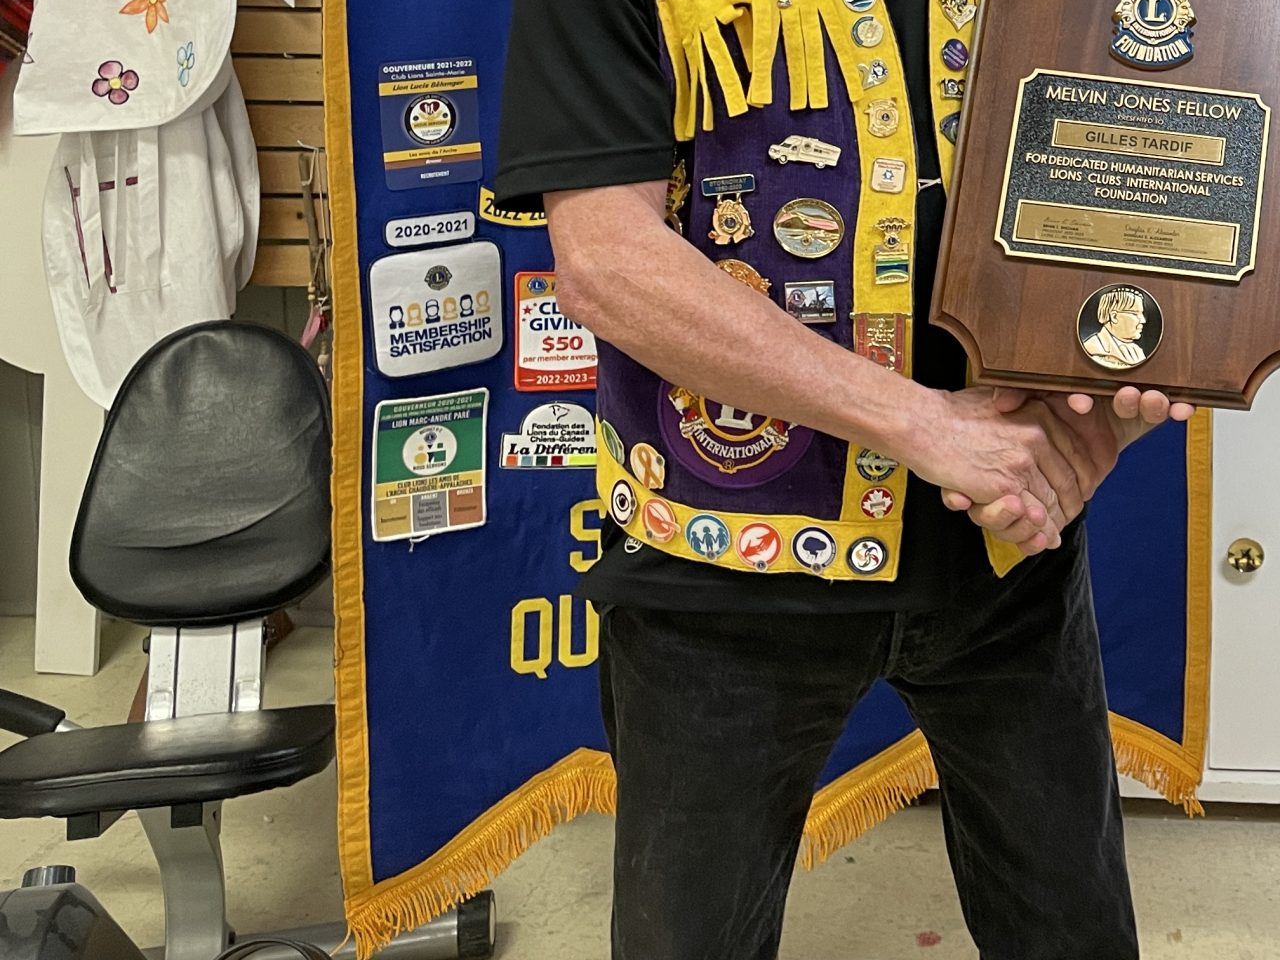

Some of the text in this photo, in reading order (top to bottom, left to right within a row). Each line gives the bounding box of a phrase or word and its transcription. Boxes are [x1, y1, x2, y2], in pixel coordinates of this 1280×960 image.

[1115, 35, 1190, 62] FOUNDATION
[383, 60, 473, 74] GOUVERNEURE 2021-2022
[391, 73, 407, 81] Club
[1045, 85, 1241, 121] MELVIN JONES FELLOW
[1117, 114, 1153, 123] PRESENTED
[1085, 131, 1194, 153] GILLES TARDIF
[1025, 152, 1244, 187] FOR DEDICATED HUMANITARIAN SERVICES
[1049, 168, 1211, 197] LIONS CLUBS INTERNATIONAL
[1094, 187, 1168, 205] FOUNDATION
[394, 218, 468, 238] 2020-2021
[390, 316, 491, 346] MEMBERSHIP
[529, 317, 583, 331] GIVIN
[389, 327, 492, 357] SATISFACTION
[542, 336, 584, 353] $50
[537, 353, 569, 361] member
[536, 373, 588, 384] 2022-2023
[391, 420, 408, 429] LION
[508, 443, 597, 455] La Différen
[693, 428, 775, 460] INTERNATIONAL
